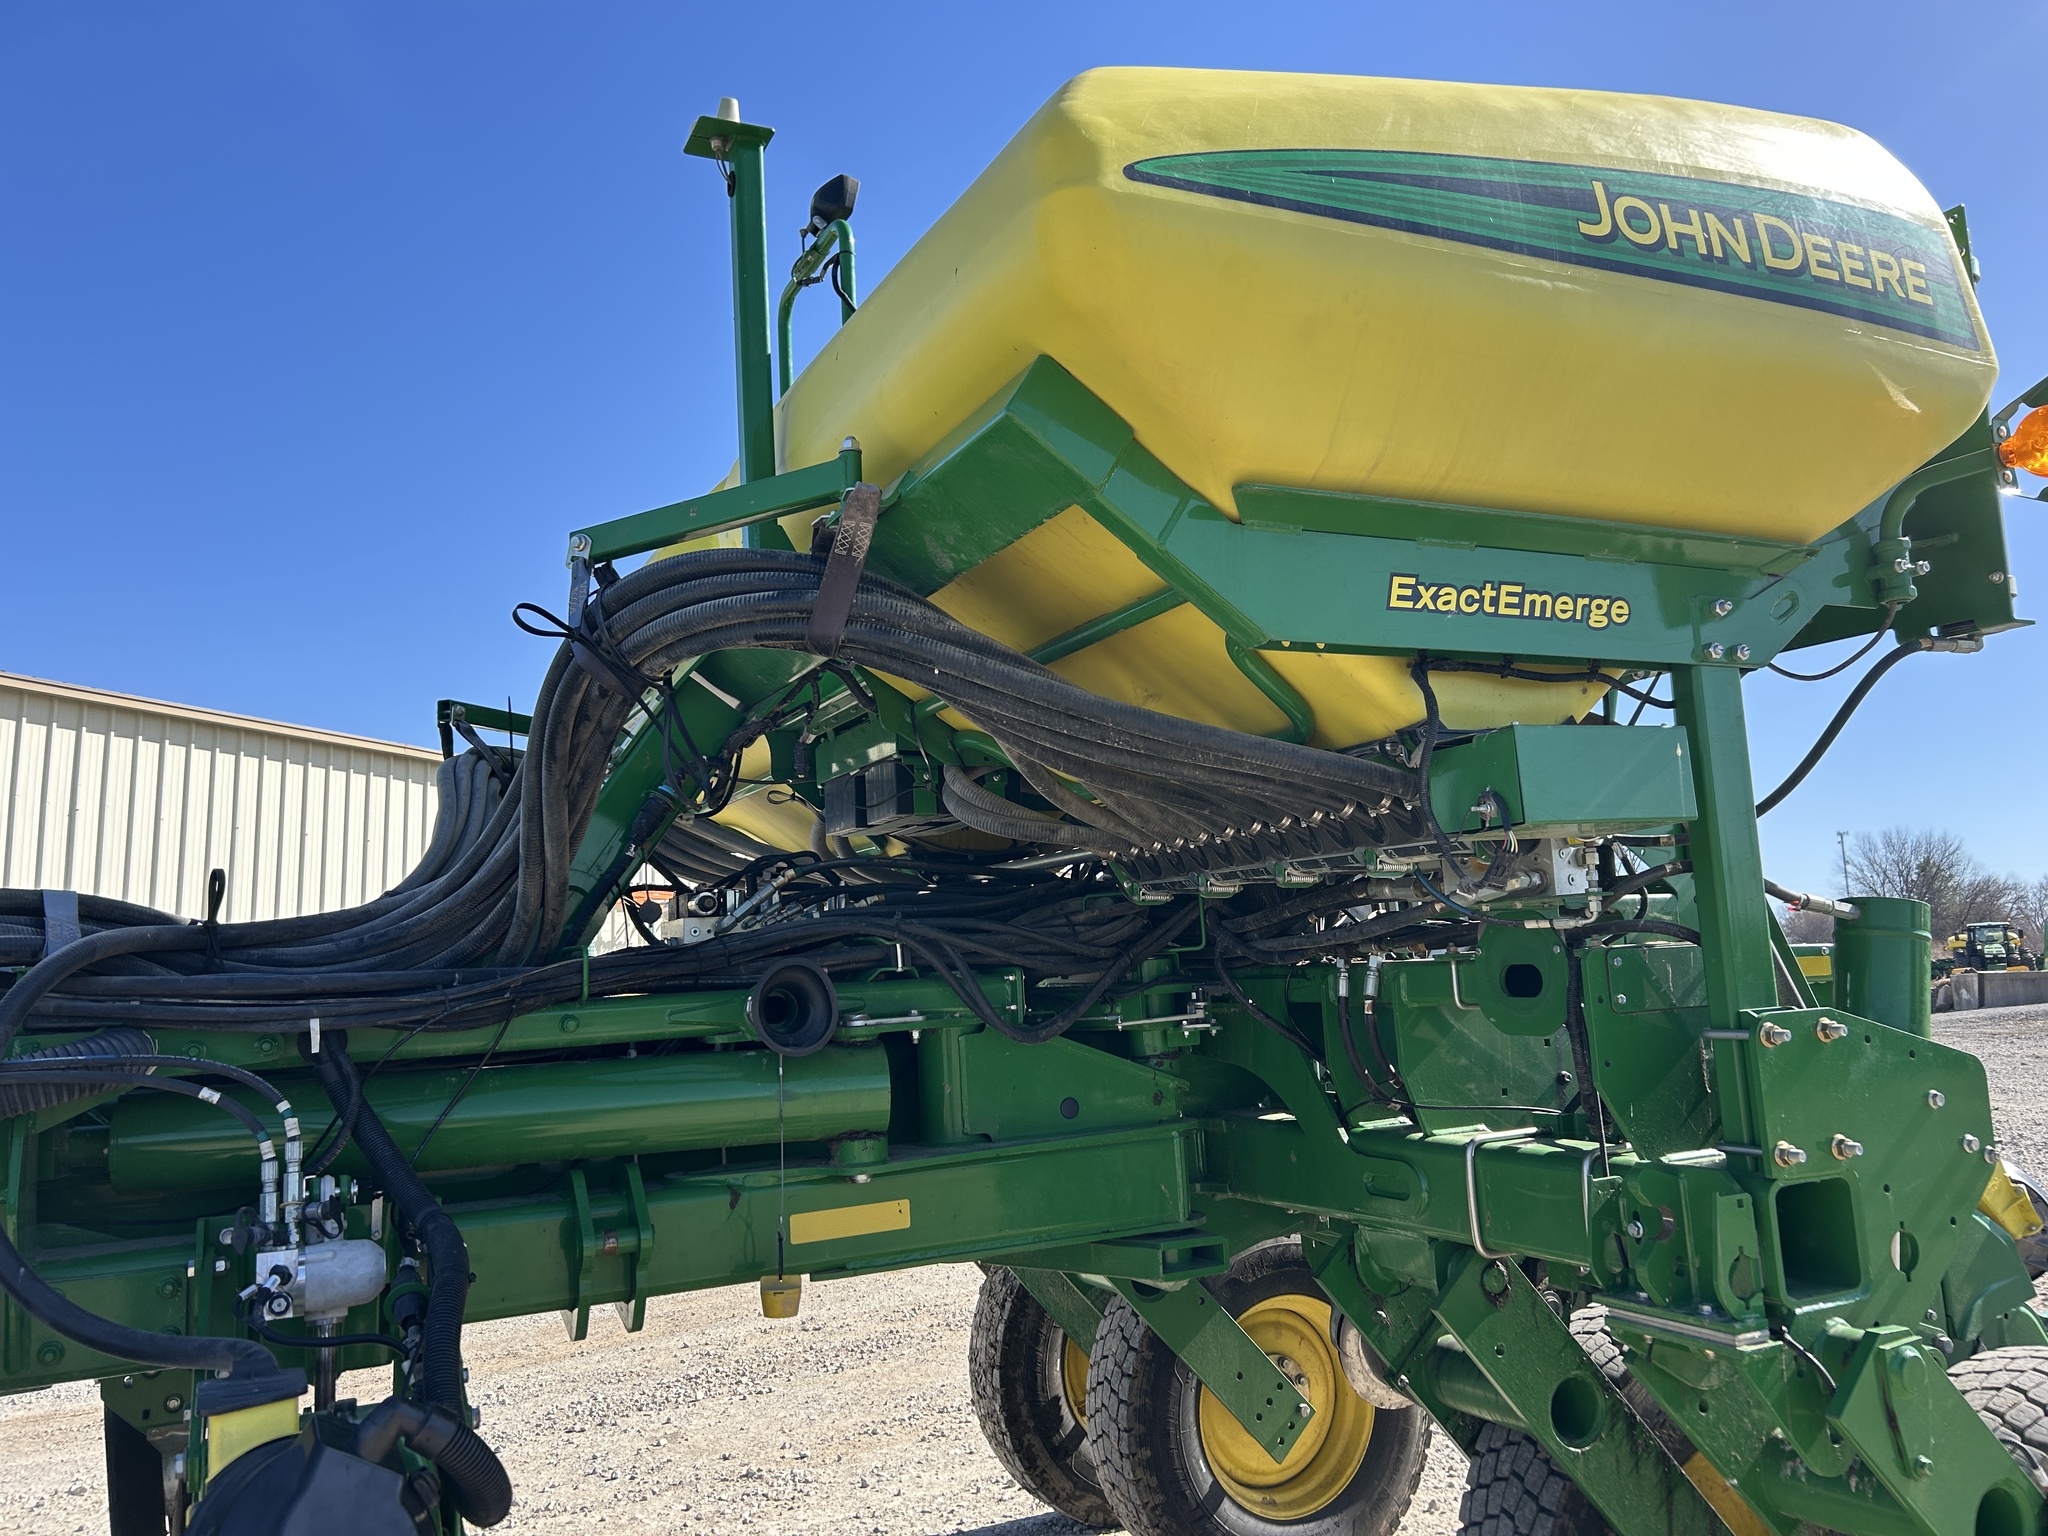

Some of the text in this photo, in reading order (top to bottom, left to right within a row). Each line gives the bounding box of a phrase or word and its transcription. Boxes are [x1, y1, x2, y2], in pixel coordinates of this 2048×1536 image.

[1578, 180, 1933, 305] JOHN DEERE
[1389, 576, 1630, 628] ExactEmerge
[1387, 849, 1398, 858] 3
[1418, 845, 1430, 855] 2
